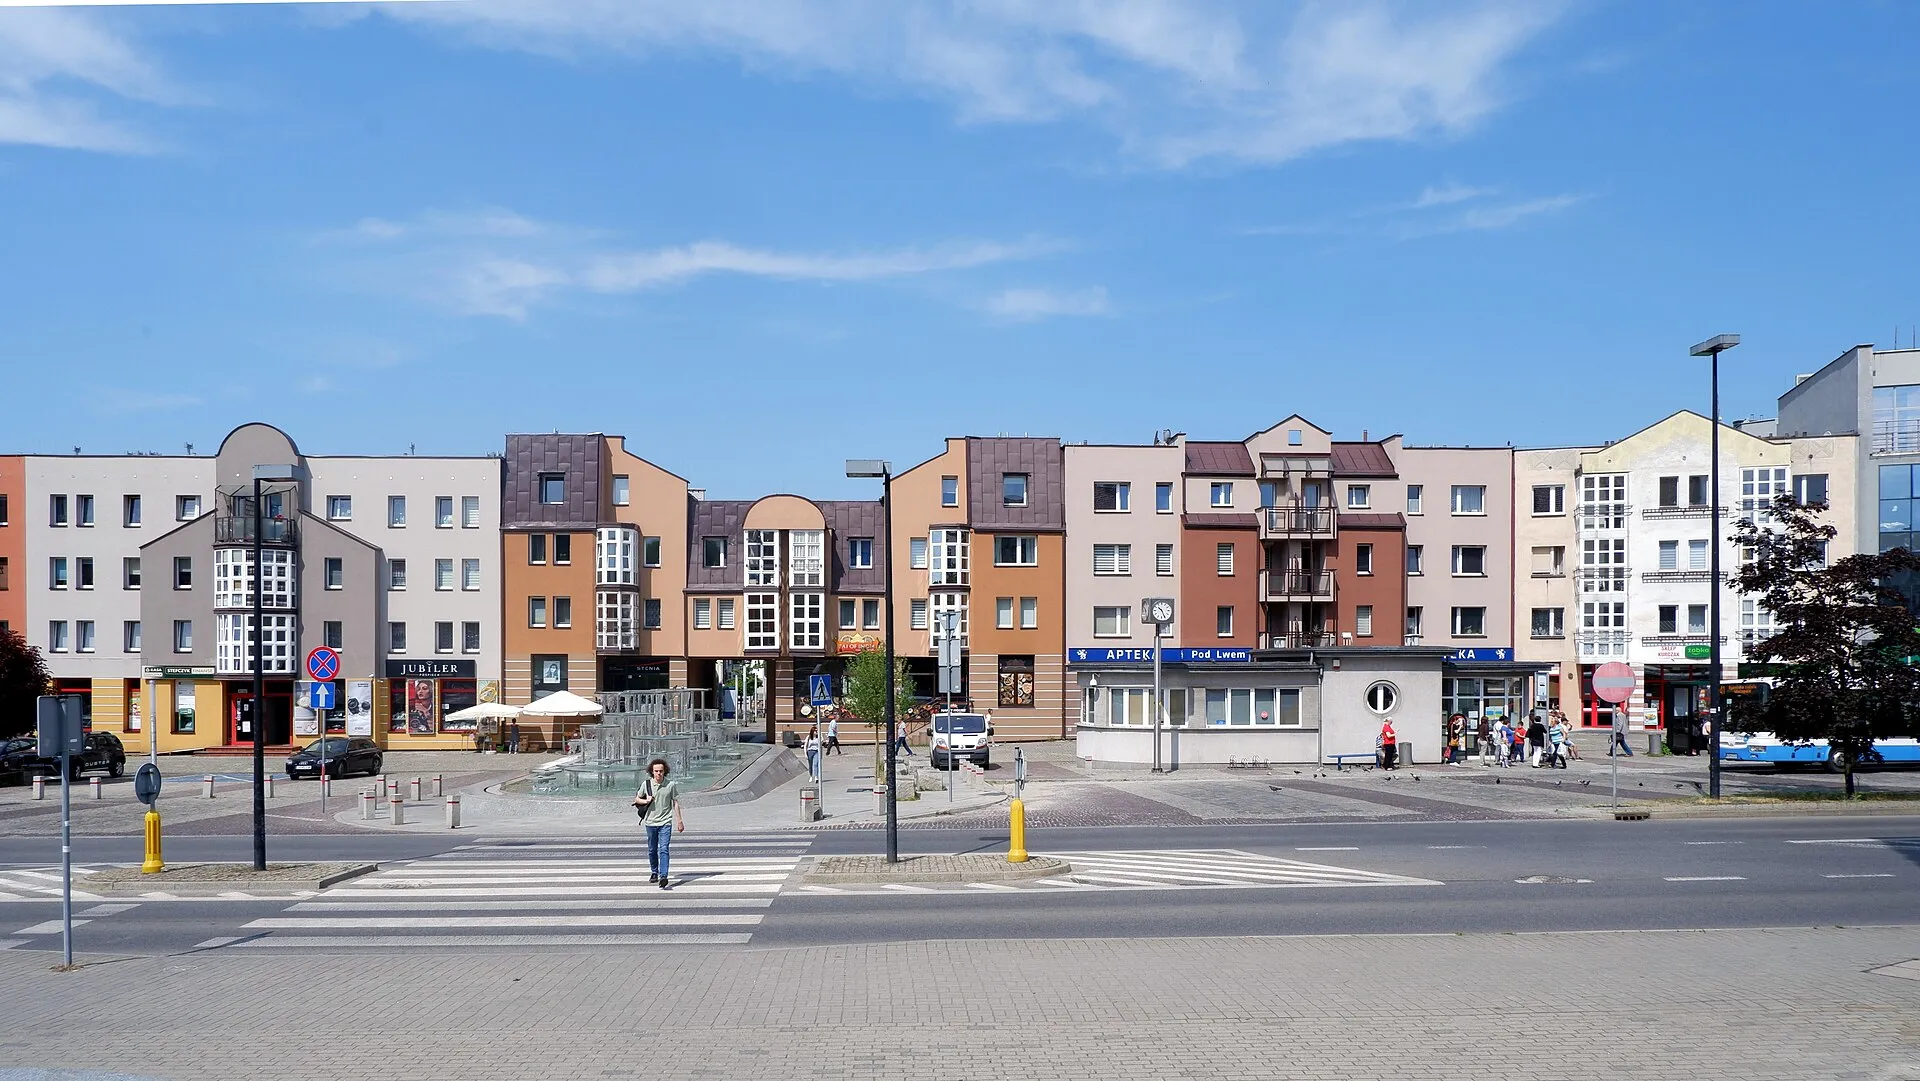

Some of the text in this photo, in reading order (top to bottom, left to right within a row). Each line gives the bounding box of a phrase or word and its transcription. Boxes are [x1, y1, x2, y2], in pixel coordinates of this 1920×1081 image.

[1106, 649, 1246, 660] APTEK Pod Lwem
